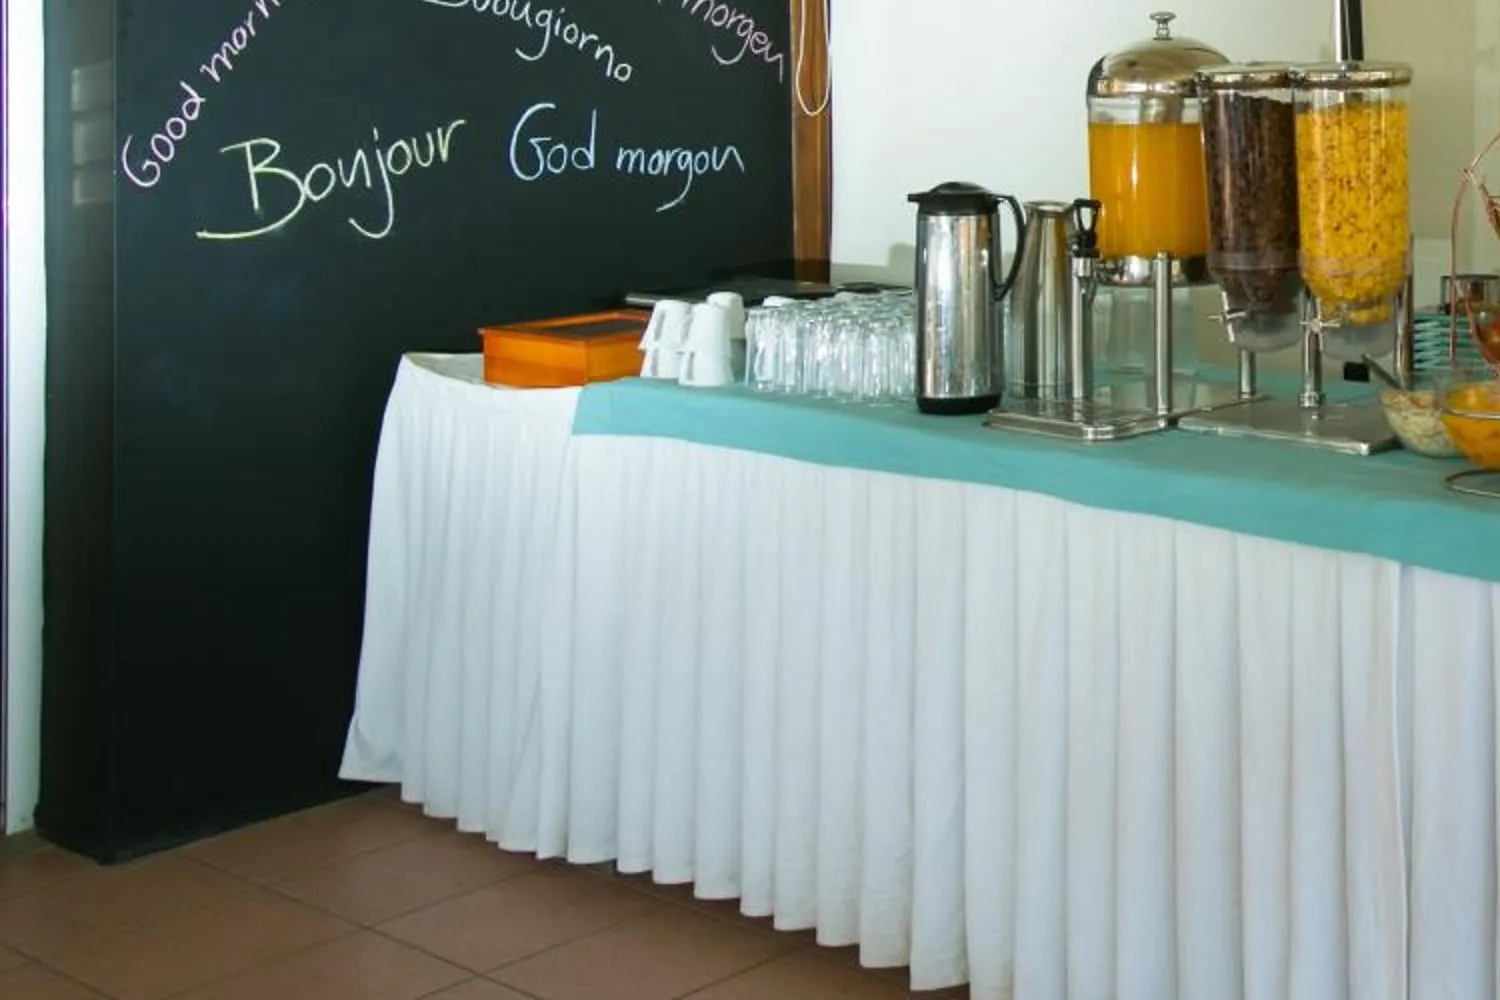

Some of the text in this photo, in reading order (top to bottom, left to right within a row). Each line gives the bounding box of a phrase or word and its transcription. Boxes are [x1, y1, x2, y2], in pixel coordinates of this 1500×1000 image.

[122, 81, 206, 187] Good
[196, 119, 468, 239] Bonjour
[509, 102, 745, 213] God morgon
